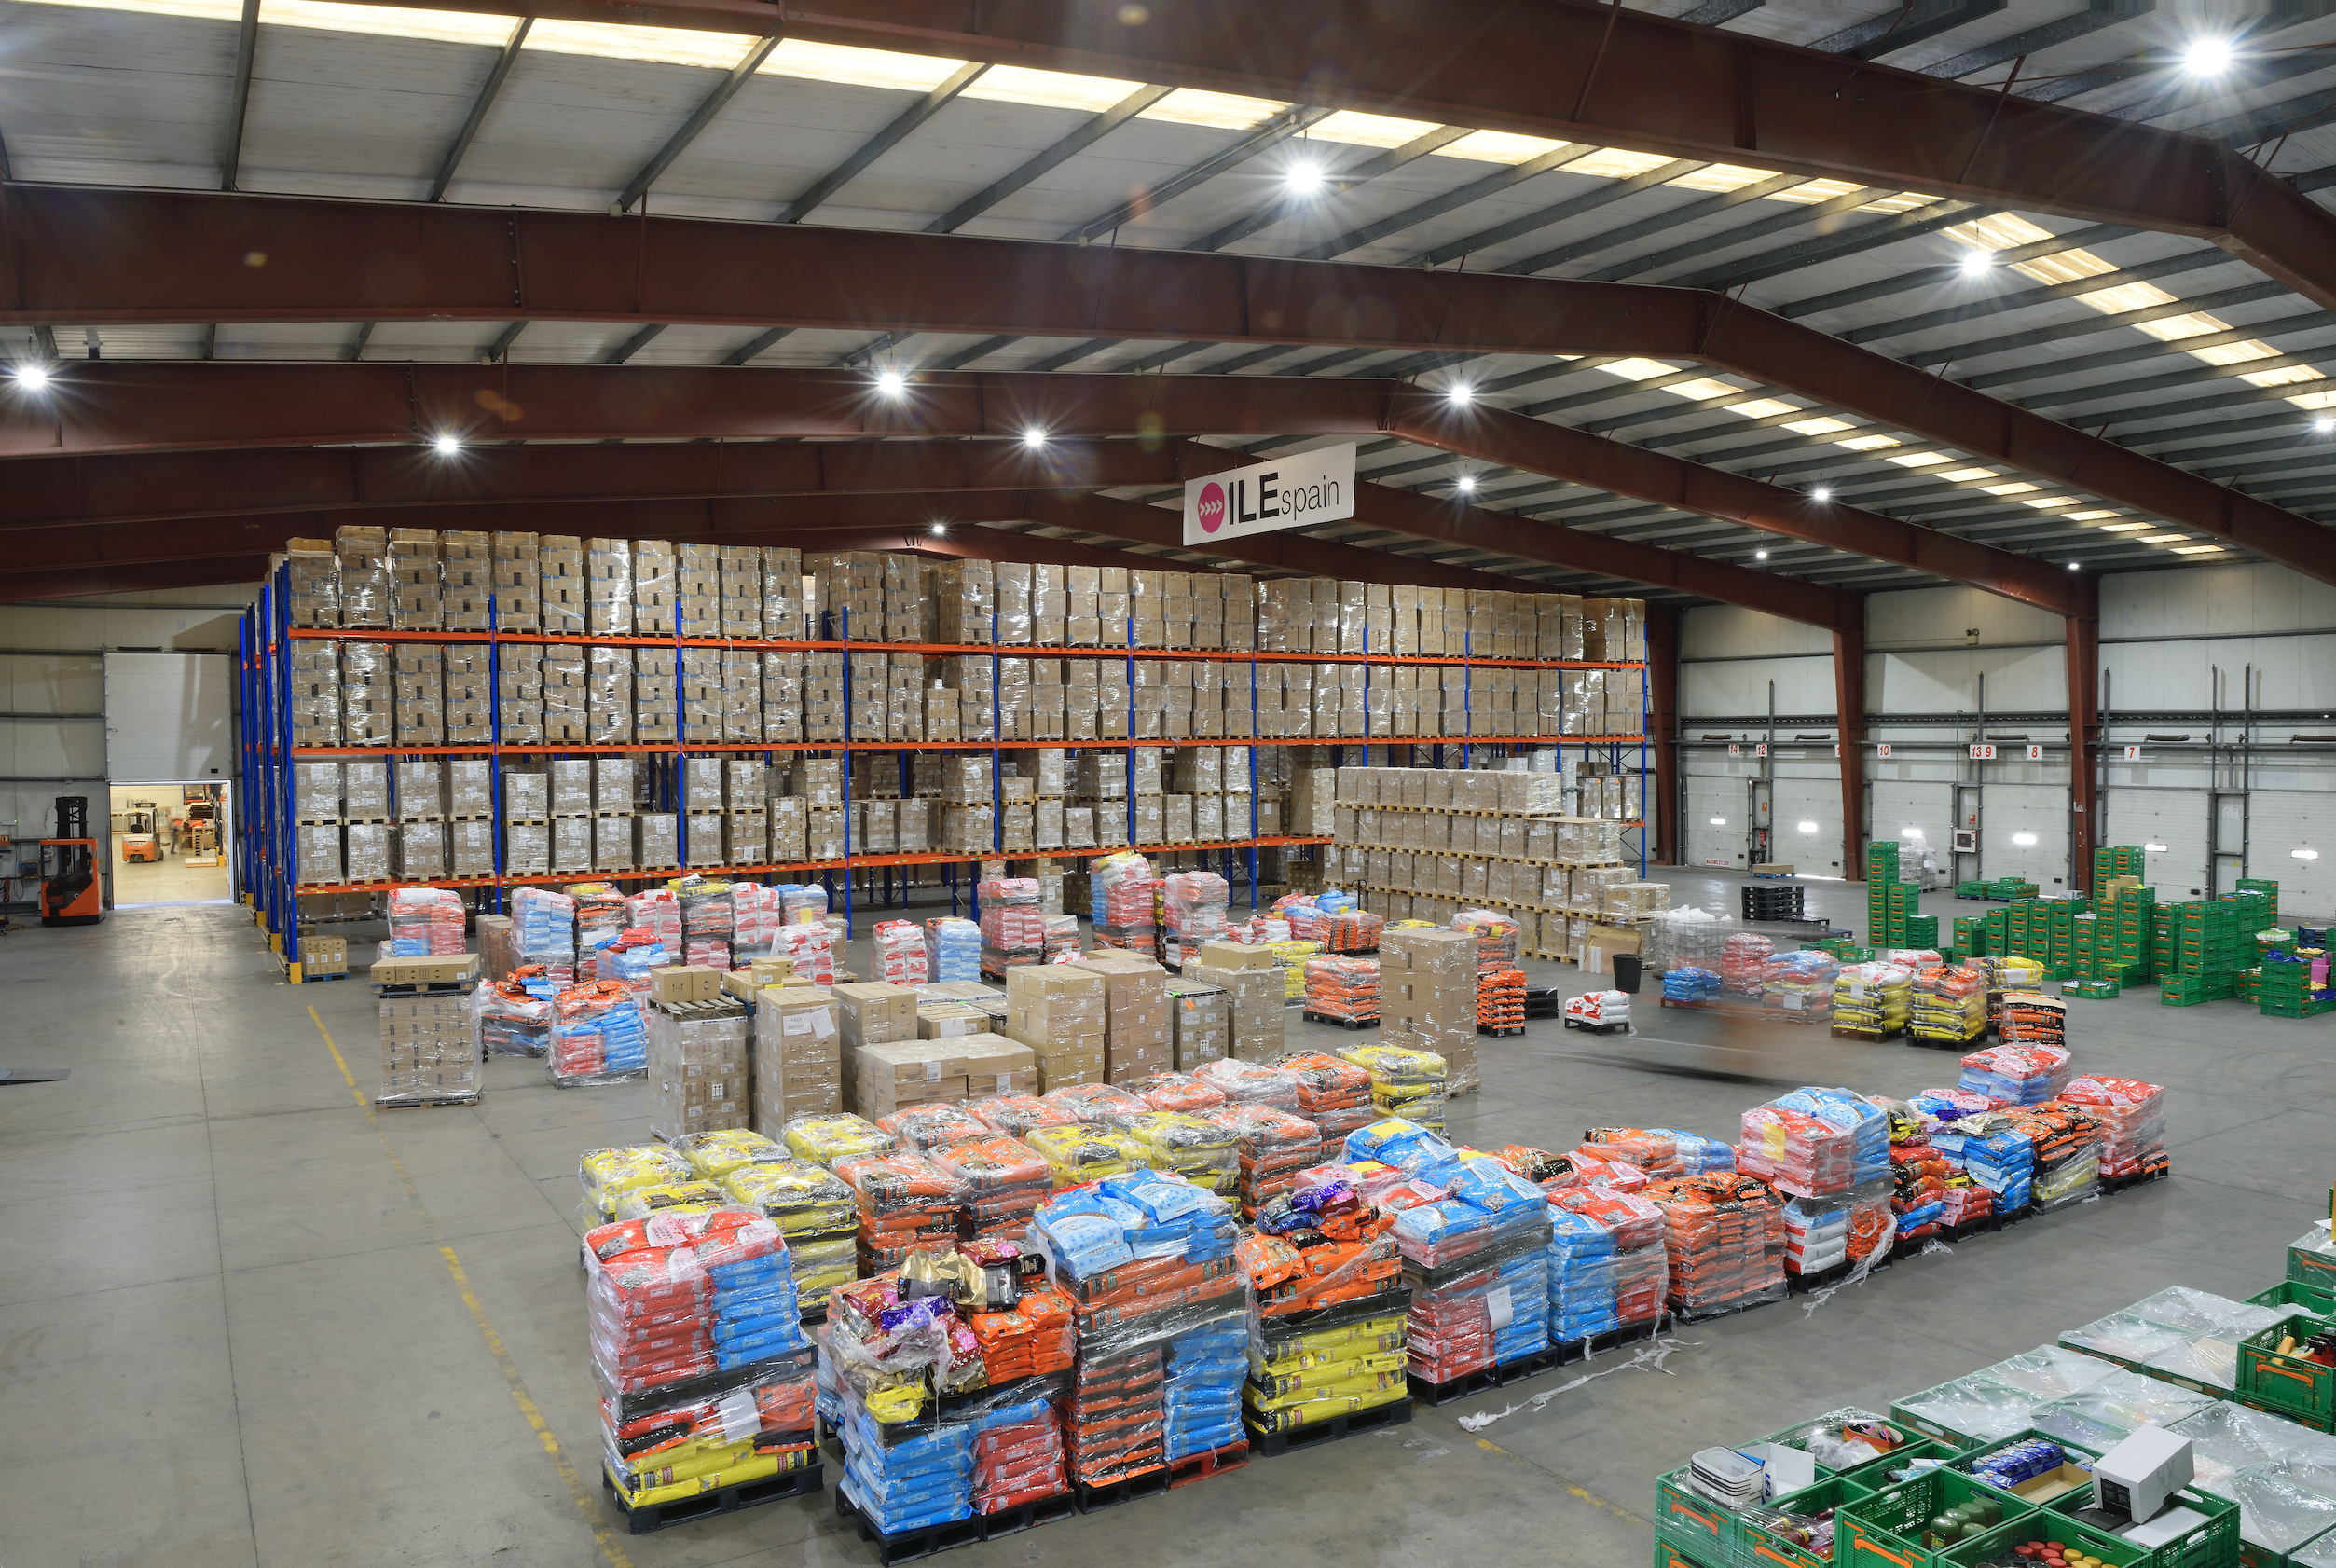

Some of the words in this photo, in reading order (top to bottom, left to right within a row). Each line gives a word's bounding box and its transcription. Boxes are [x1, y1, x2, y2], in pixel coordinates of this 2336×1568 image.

[1730, 744, 1738, 754] 14
[1757, 745, 1766, 755] 12
[1879, 745, 1889, 756] 10
[1972, 747, 1981, 757] 13
[1986, 747, 1992, 757] 9
[2031, 747, 2039, 758] 8
[2129, 747, 2135, 759] 7
